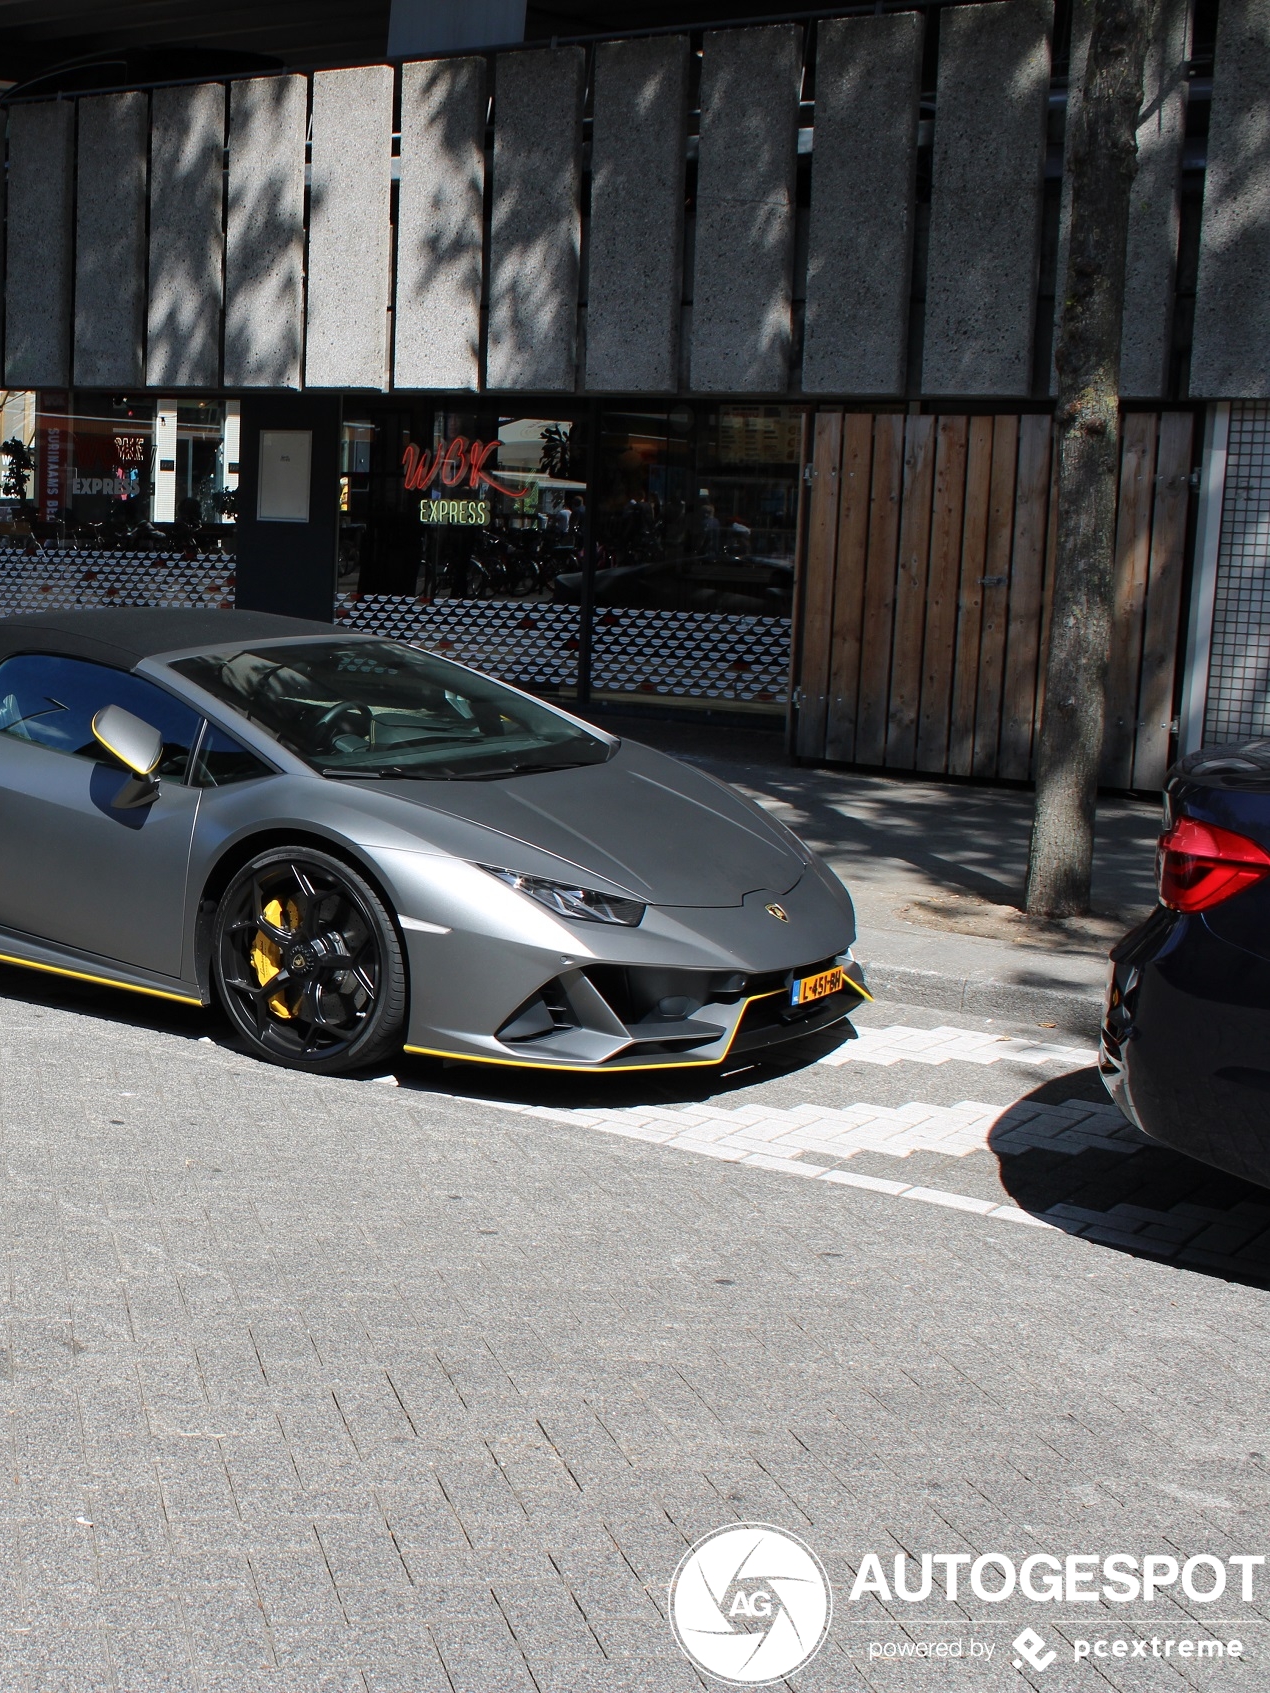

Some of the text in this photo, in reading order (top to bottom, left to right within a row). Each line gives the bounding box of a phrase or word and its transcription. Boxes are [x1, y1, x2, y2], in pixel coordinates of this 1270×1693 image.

[46, 427, 60, 495] SURINAAMS
[402, 437, 530, 497] WOK
[72, 478, 141, 495] EXPRESS
[419, 499, 488, 525] EXPRESS
[802, 969, 842, 1001] L-451-BH
